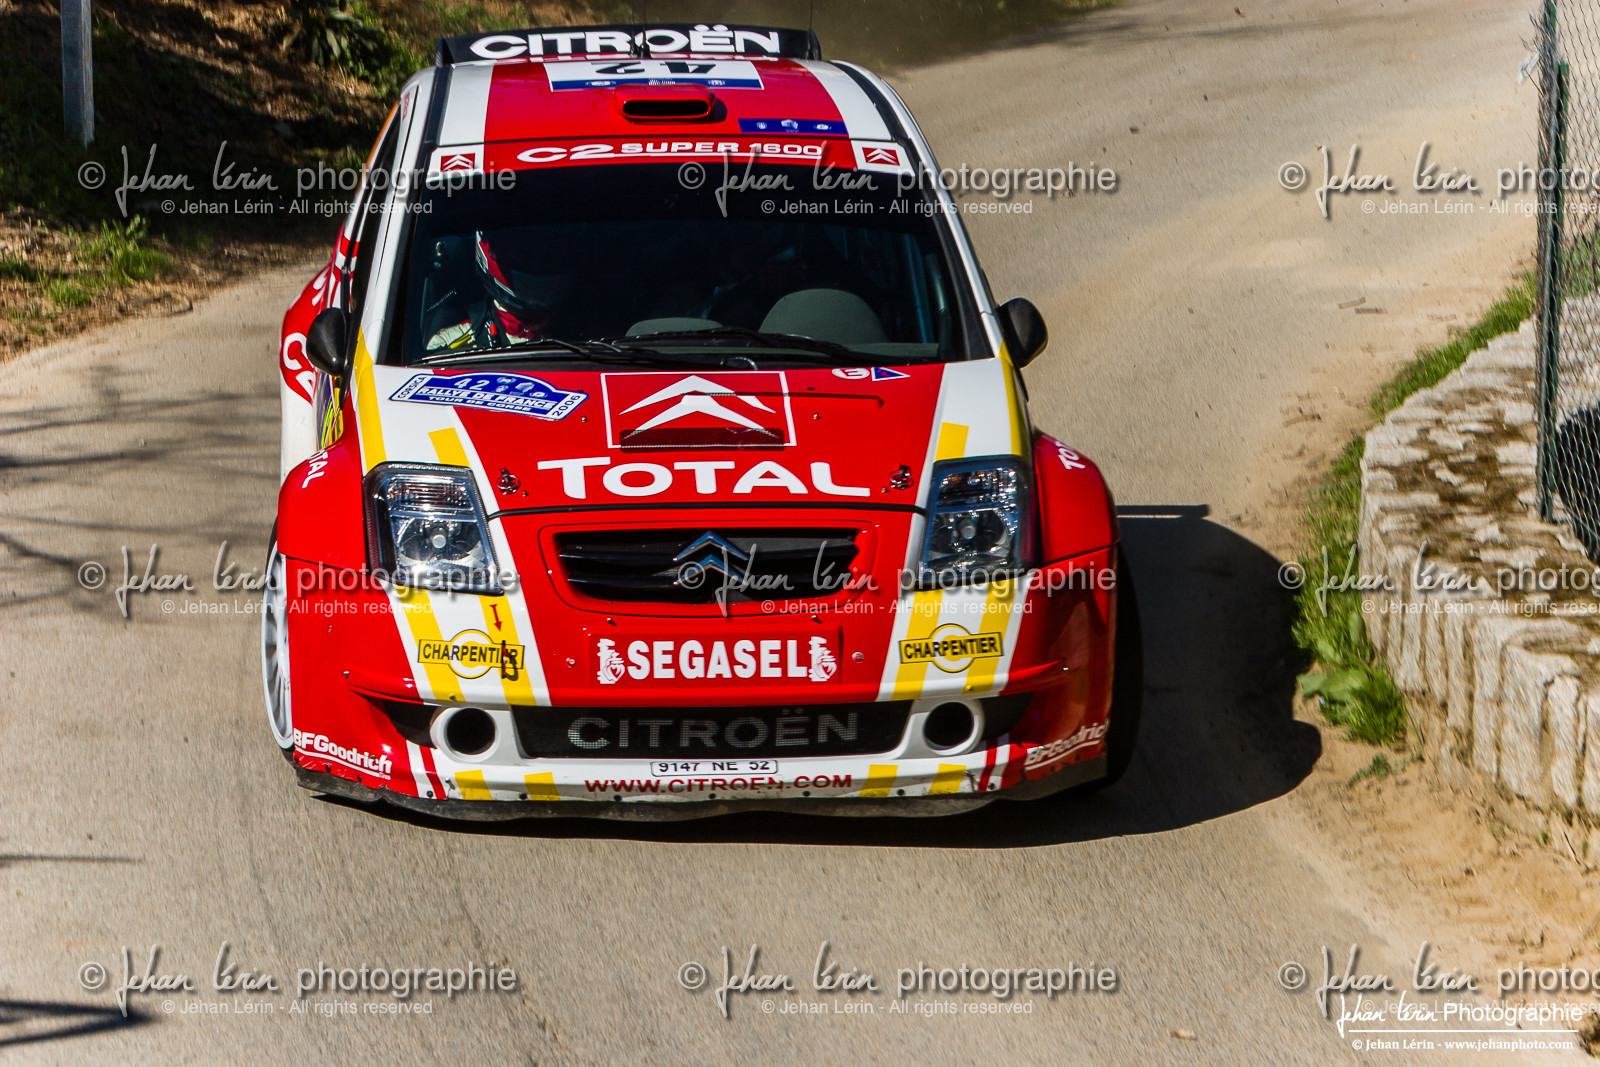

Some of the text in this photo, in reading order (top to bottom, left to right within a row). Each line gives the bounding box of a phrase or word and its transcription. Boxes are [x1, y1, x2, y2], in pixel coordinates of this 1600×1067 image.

[470, 24, 779, 59] CITROËN
[517, 141, 822, 163] C2 SUPER 1600
[454, 378, 490, 391] 42
[416, 387, 470, 400] RALLYE
[472, 391, 494, 402] DE
[495, 393, 558, 410] FRANCE
[429, 396, 463, 404] TOUR
[488, 402, 532, 412] CORSE
[552, 395, 581, 416] 2006
[537, 456, 870, 499] TOTAL
[904, 636, 999, 659] CHARPENTIER
[627, 639, 808, 680] SEGASEL
[568, 708, 859, 749] CITROËN
[293, 728, 392, 774] BFGoodrich
[659, 761, 770, 772] 9147 NE 52
